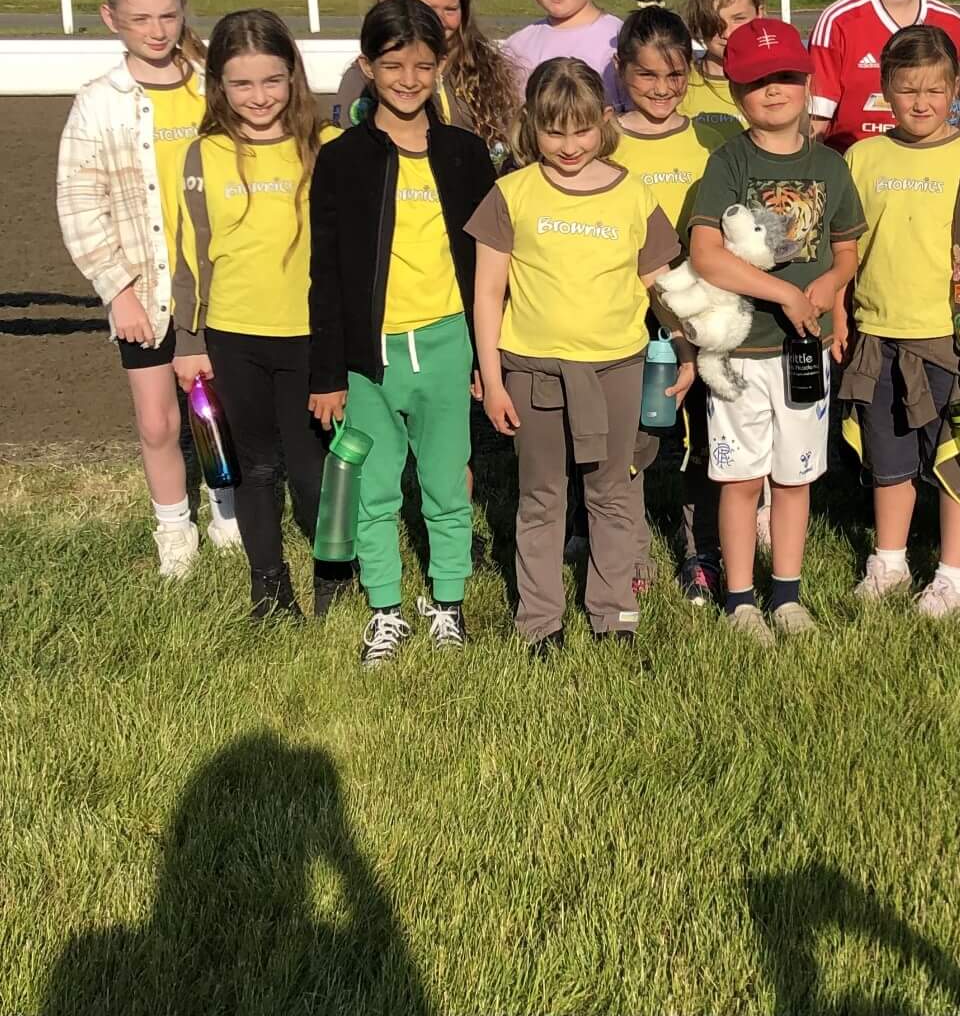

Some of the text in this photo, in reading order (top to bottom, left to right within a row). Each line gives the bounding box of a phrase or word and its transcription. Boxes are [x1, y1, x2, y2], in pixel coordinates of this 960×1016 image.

[641, 168, 693, 185] ownies
[875, 175, 945, 194] Brownies
[537, 216, 620, 240] Brownies
